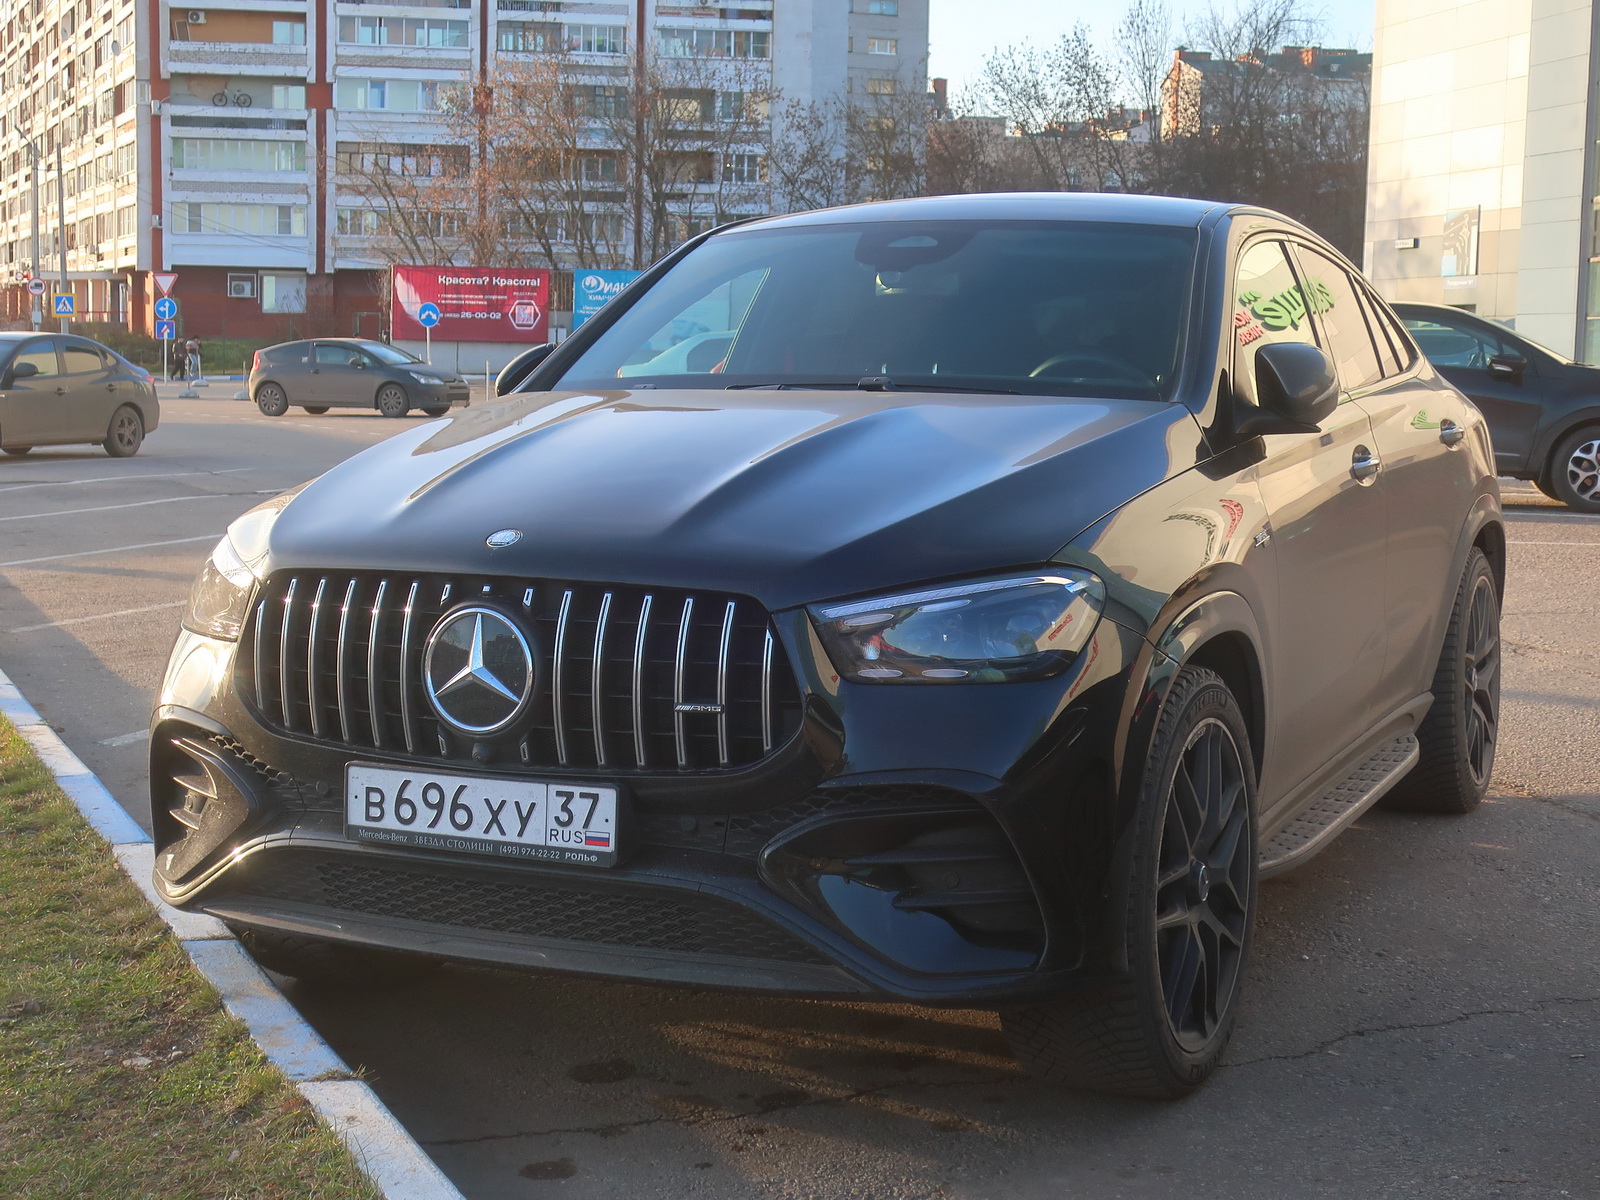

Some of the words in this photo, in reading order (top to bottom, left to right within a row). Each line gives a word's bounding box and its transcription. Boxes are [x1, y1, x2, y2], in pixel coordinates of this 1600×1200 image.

[438, 274, 489, 286] Красота?
[492, 276, 540, 288] Красота!
[460, 311, 502, 319] 26-00-02
[553, 790, 600, 830] 37
[549, 828, 584, 844] RUS
[358, 828, 408, 843] Mercedes-Benz
[414, 835, 445, 847] ЗВЕЗДА
[446, 839, 494, 852] СТОЛИЦЫ
[499, 845, 520, 856] (495)
[521, 846, 560, 860] 974-22-22
[565, 852, 598, 863] РОЛЬФ
